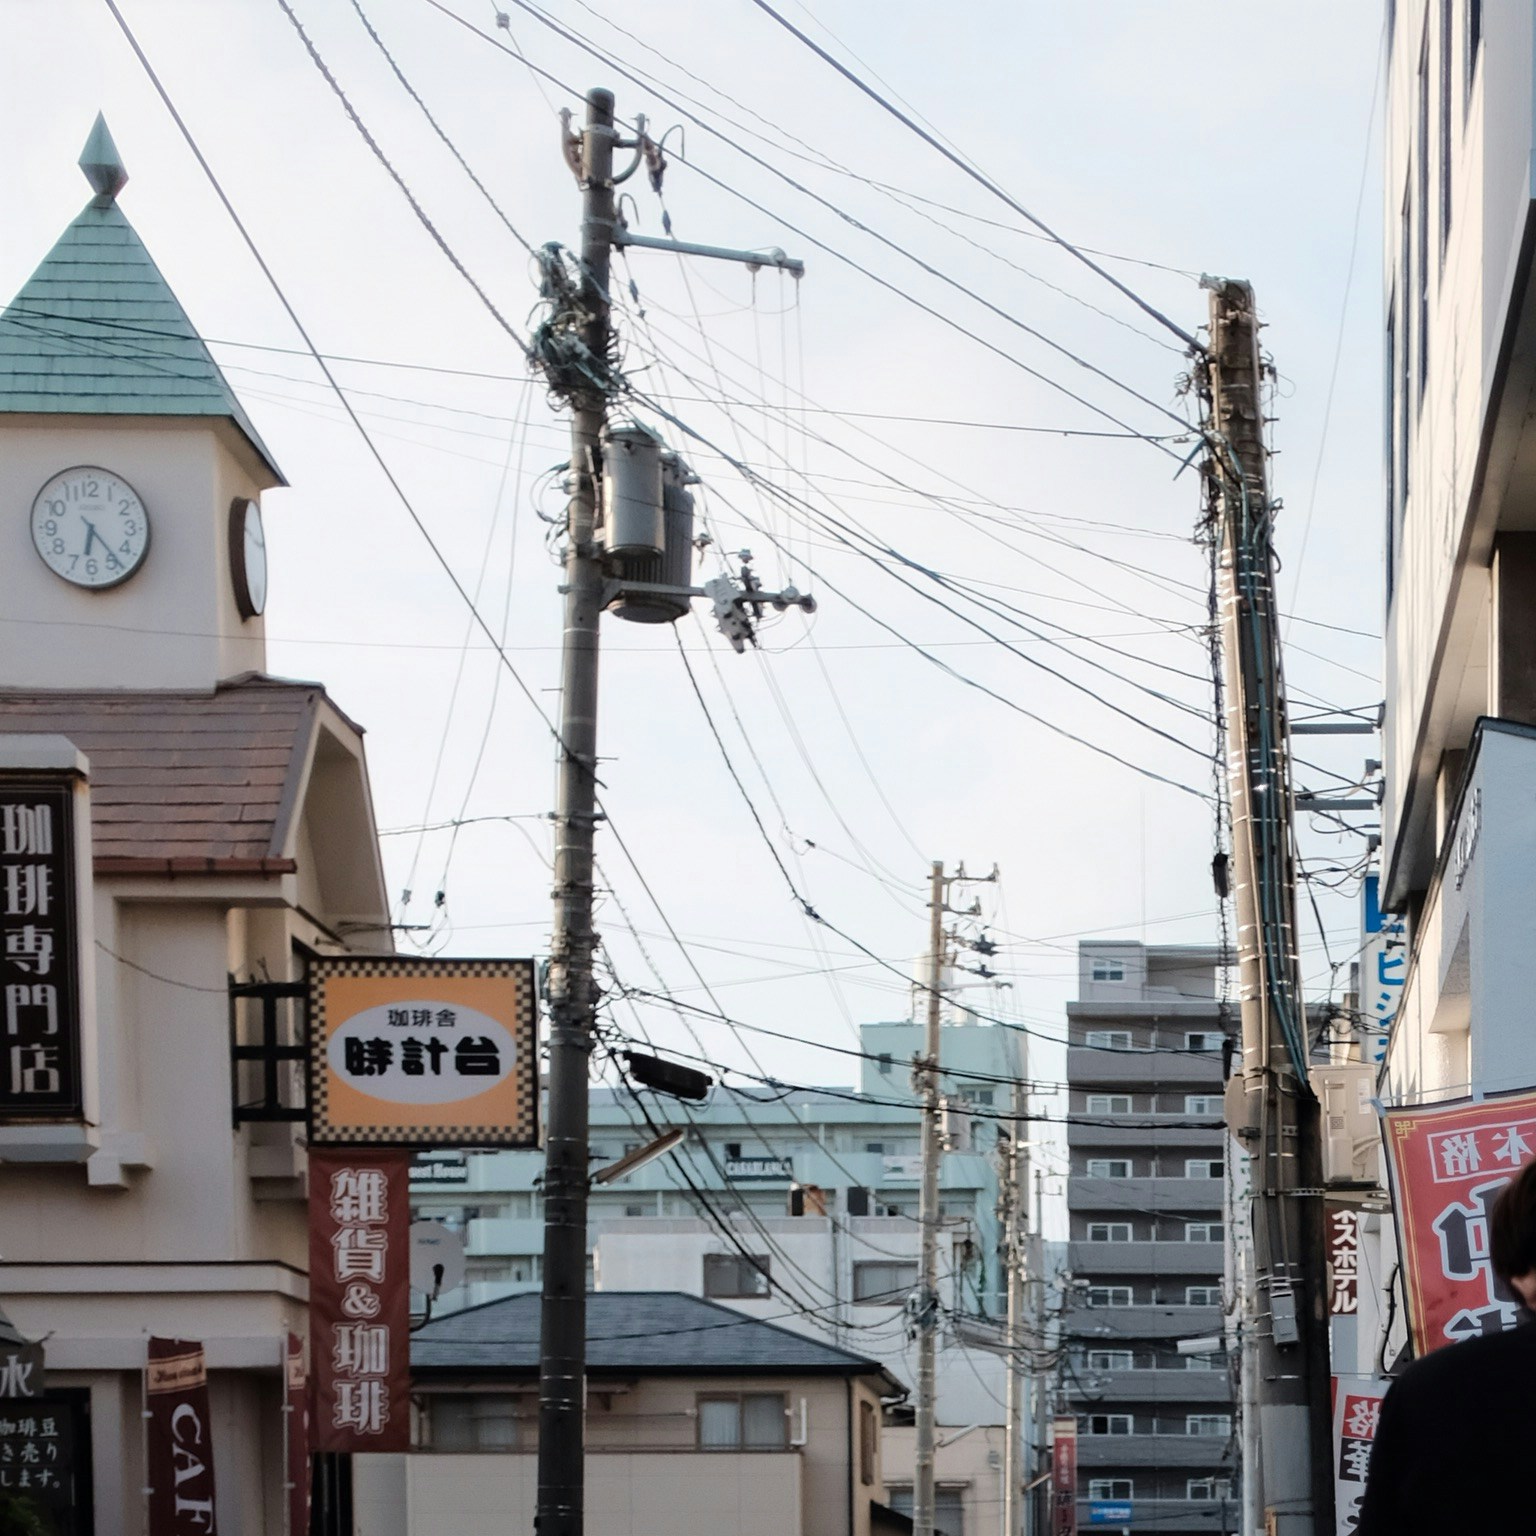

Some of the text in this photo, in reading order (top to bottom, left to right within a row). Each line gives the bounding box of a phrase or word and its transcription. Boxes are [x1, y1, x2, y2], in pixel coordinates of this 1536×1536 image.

[83, 481, 98, 497] 12
[119, 499, 130, 516] 2
[45, 519, 57, 536] 9
[125, 519, 136, 536] 3
[53, 538, 65, 555] 8
[119, 540, 131, 555] 4
[68, 554, 79, 571] 7
[85, 559, 98, 576] 6
[2, 804, 59, 1094] 珈琲専門店
[388, 1009, 456, 1027] 珈琲舎
[345, 1036, 500, 1075] 時計台
[331, 1168, 389, 1434] 雑貨&珈琲
